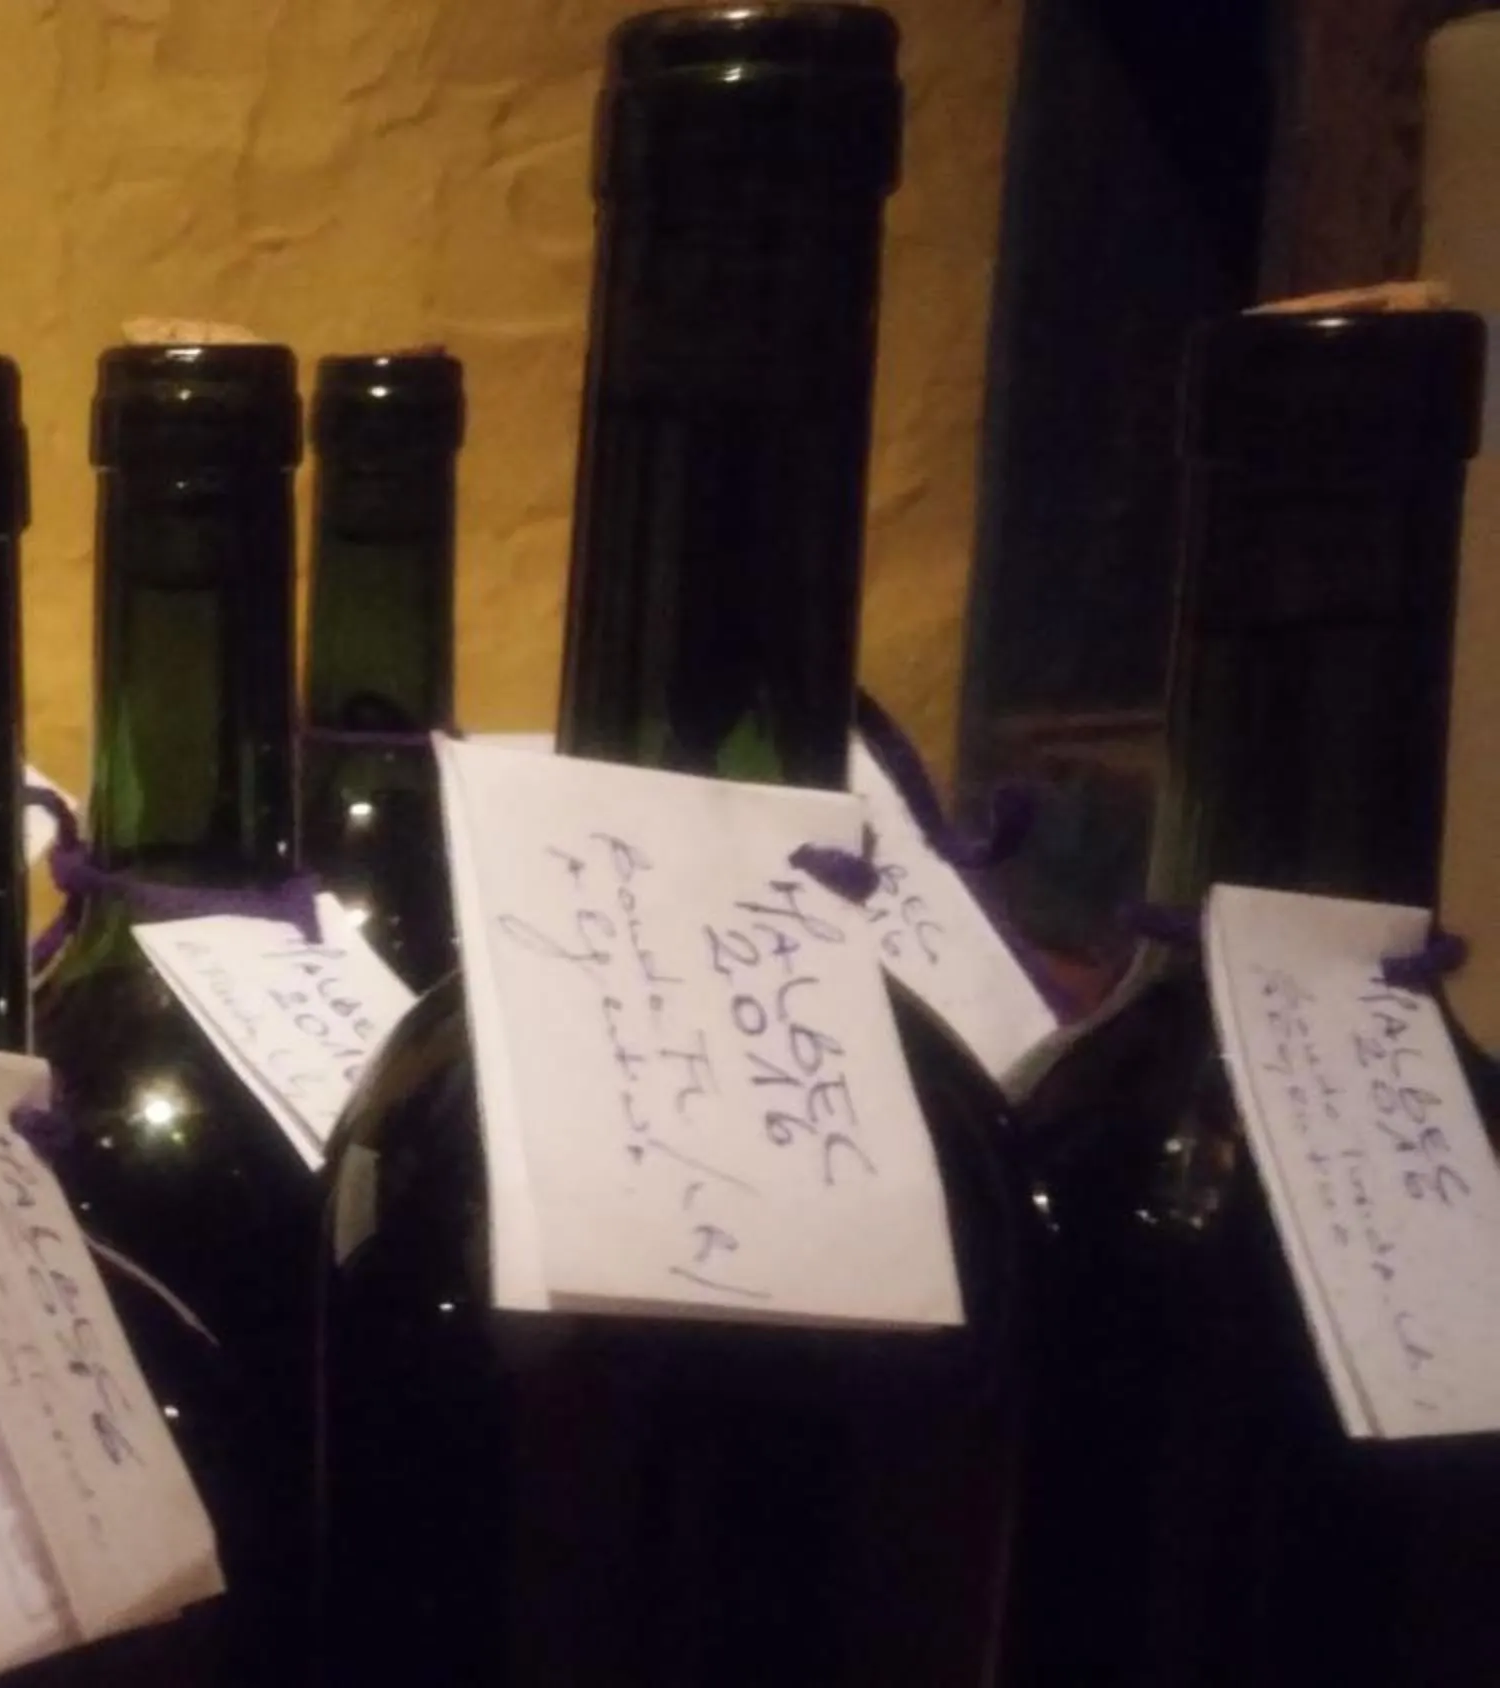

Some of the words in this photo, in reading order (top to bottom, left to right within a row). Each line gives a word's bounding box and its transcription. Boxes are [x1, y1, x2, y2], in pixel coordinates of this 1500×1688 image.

[702, 923, 818, 1148] 2016
[733, 879, 879, 1187] MALBEC
[1352, 1030, 1426, 1200] 2016
